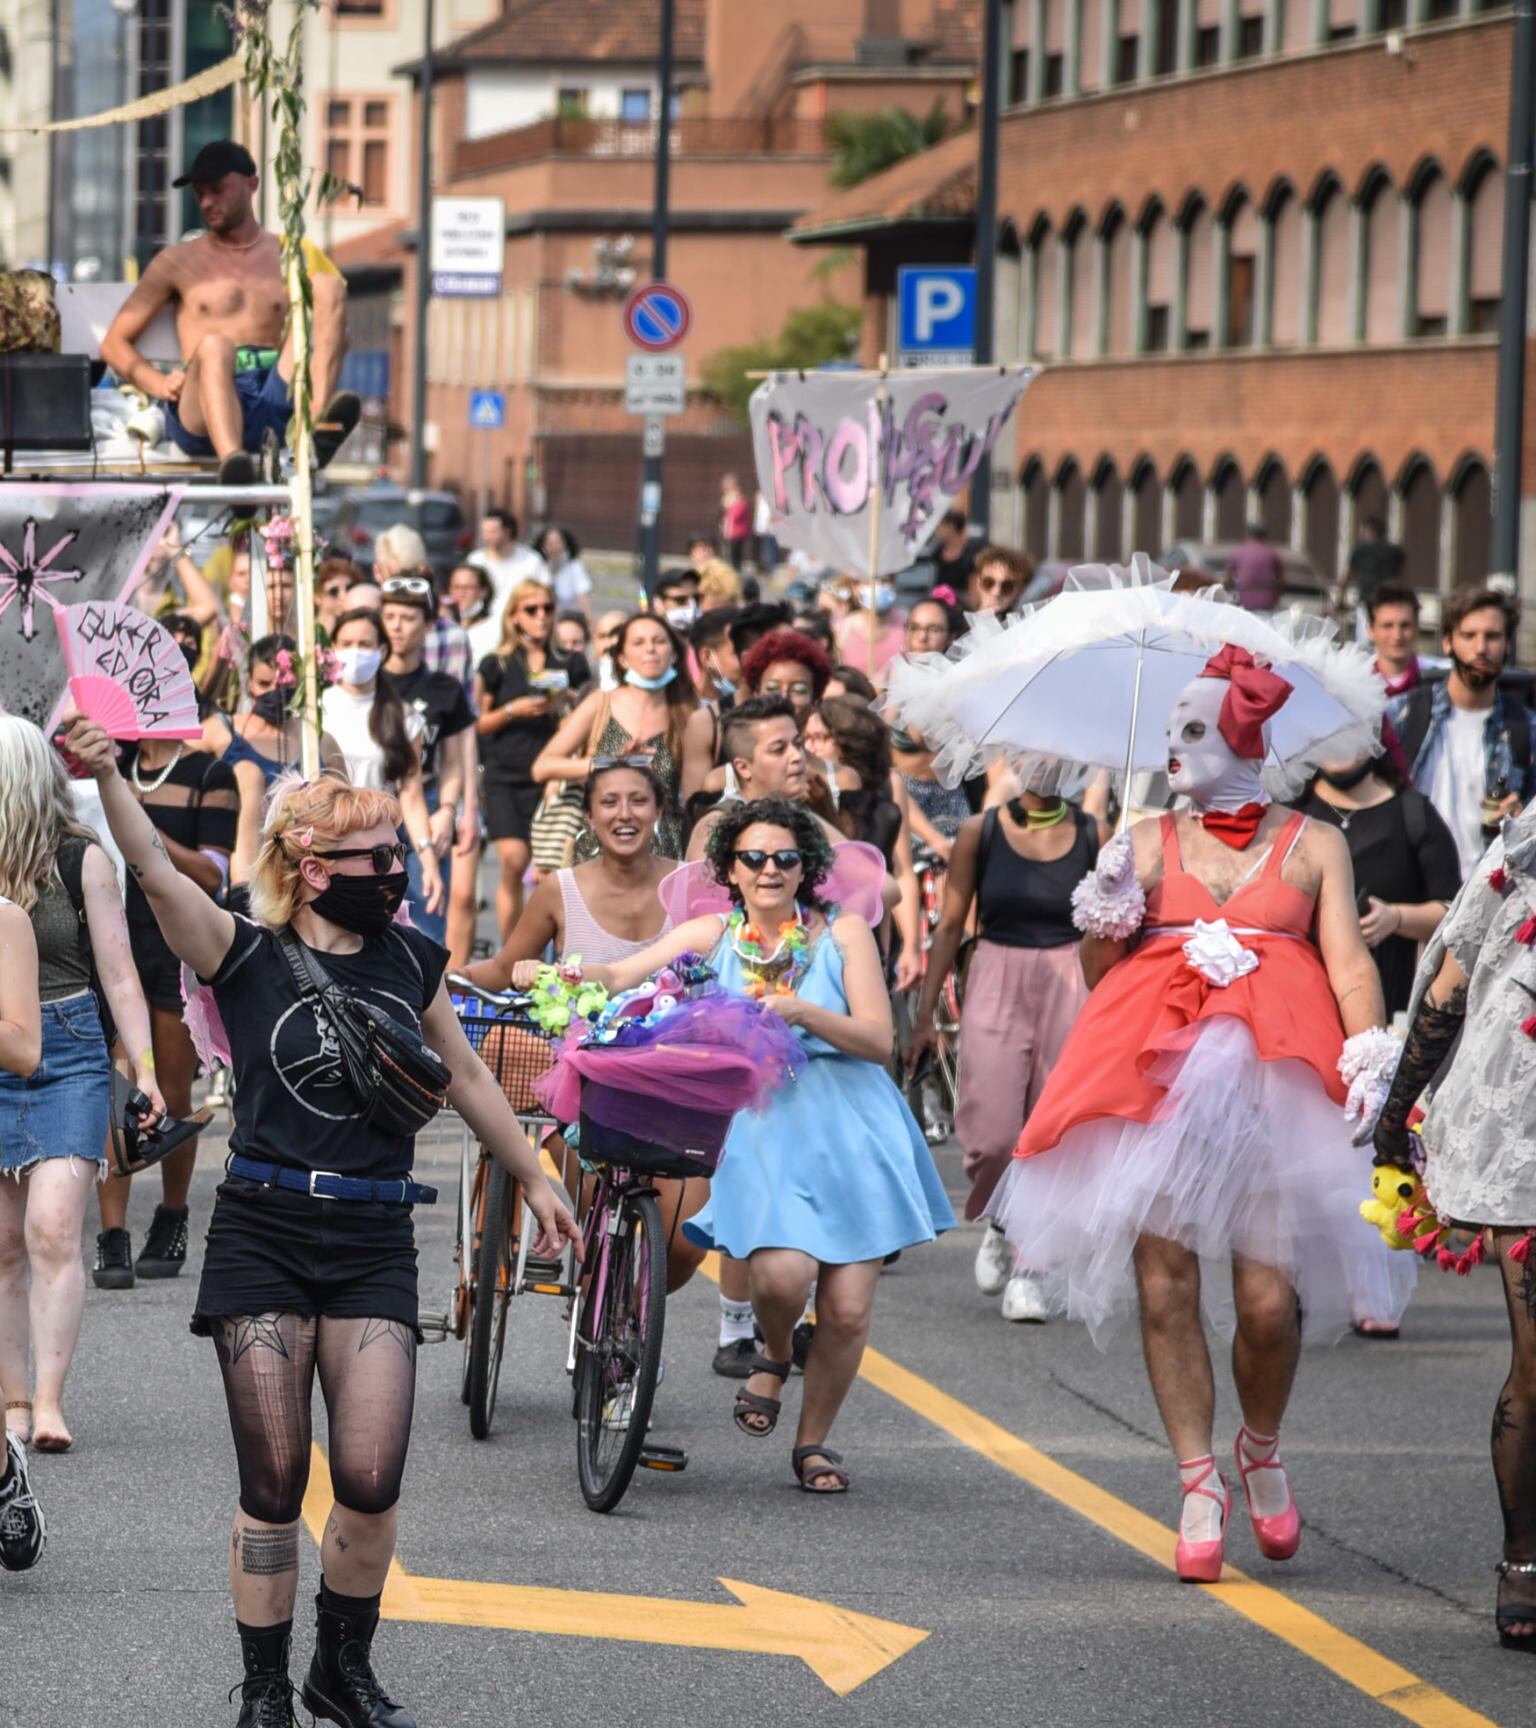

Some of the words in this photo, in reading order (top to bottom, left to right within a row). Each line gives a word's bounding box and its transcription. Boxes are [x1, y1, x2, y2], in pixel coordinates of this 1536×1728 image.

[916, 279, 965, 341] P
[77, 606, 162, 668] QUEER
[95, 648, 128, 677] ED
